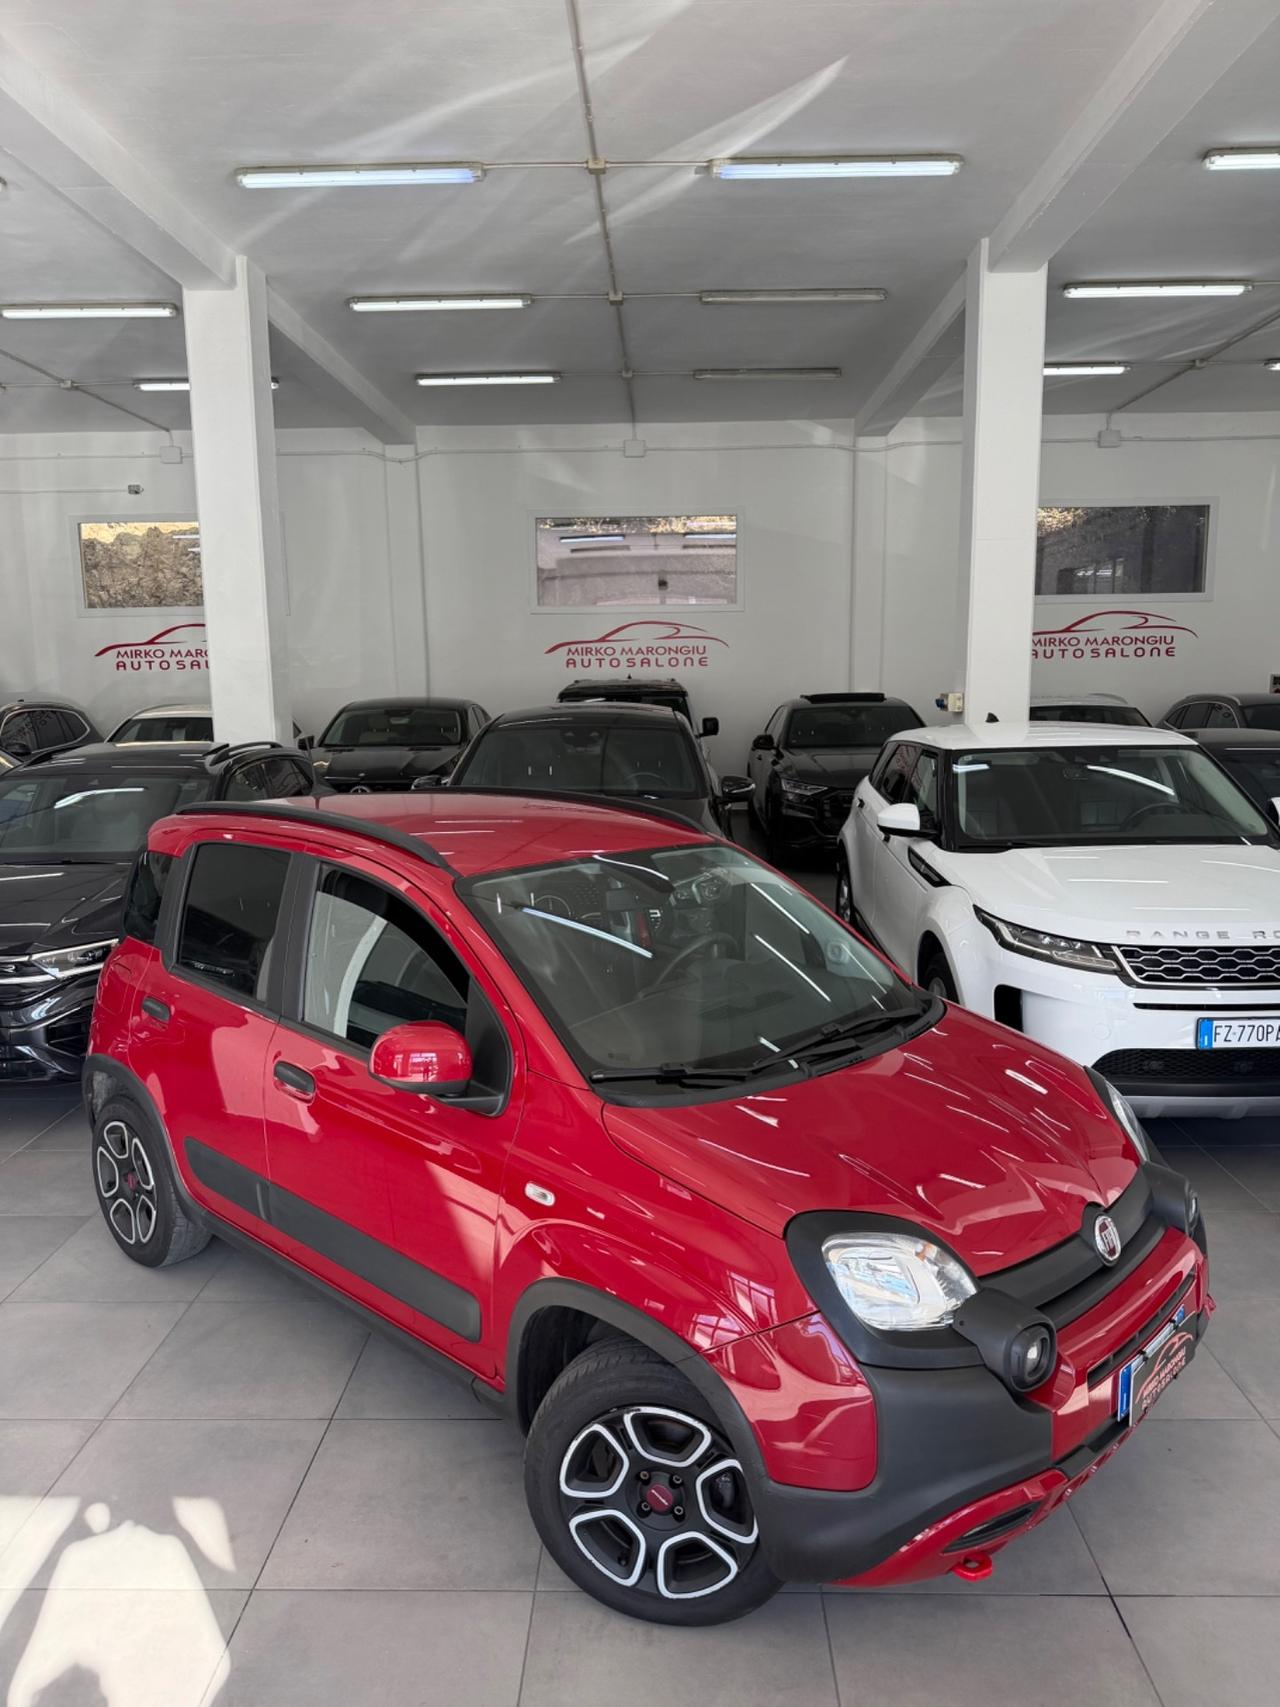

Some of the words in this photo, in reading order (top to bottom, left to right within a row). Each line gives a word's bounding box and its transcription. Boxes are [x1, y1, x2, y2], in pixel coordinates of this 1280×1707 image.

[1032, 636, 1081, 648] MIRKO
[1084, 635, 1175, 647] MARONGIU
[116, 648, 165, 659] MIRKO
[169, 648, 208, 659] MAR
[566, 646, 616, 657] MIRKO
[620, 645, 707, 656] MARONGIU
[115, 660, 209, 671] AUTOSA
[565, 656, 709, 669] AUTOSALONE
[1126, 930, 1230, 940] RANGE
